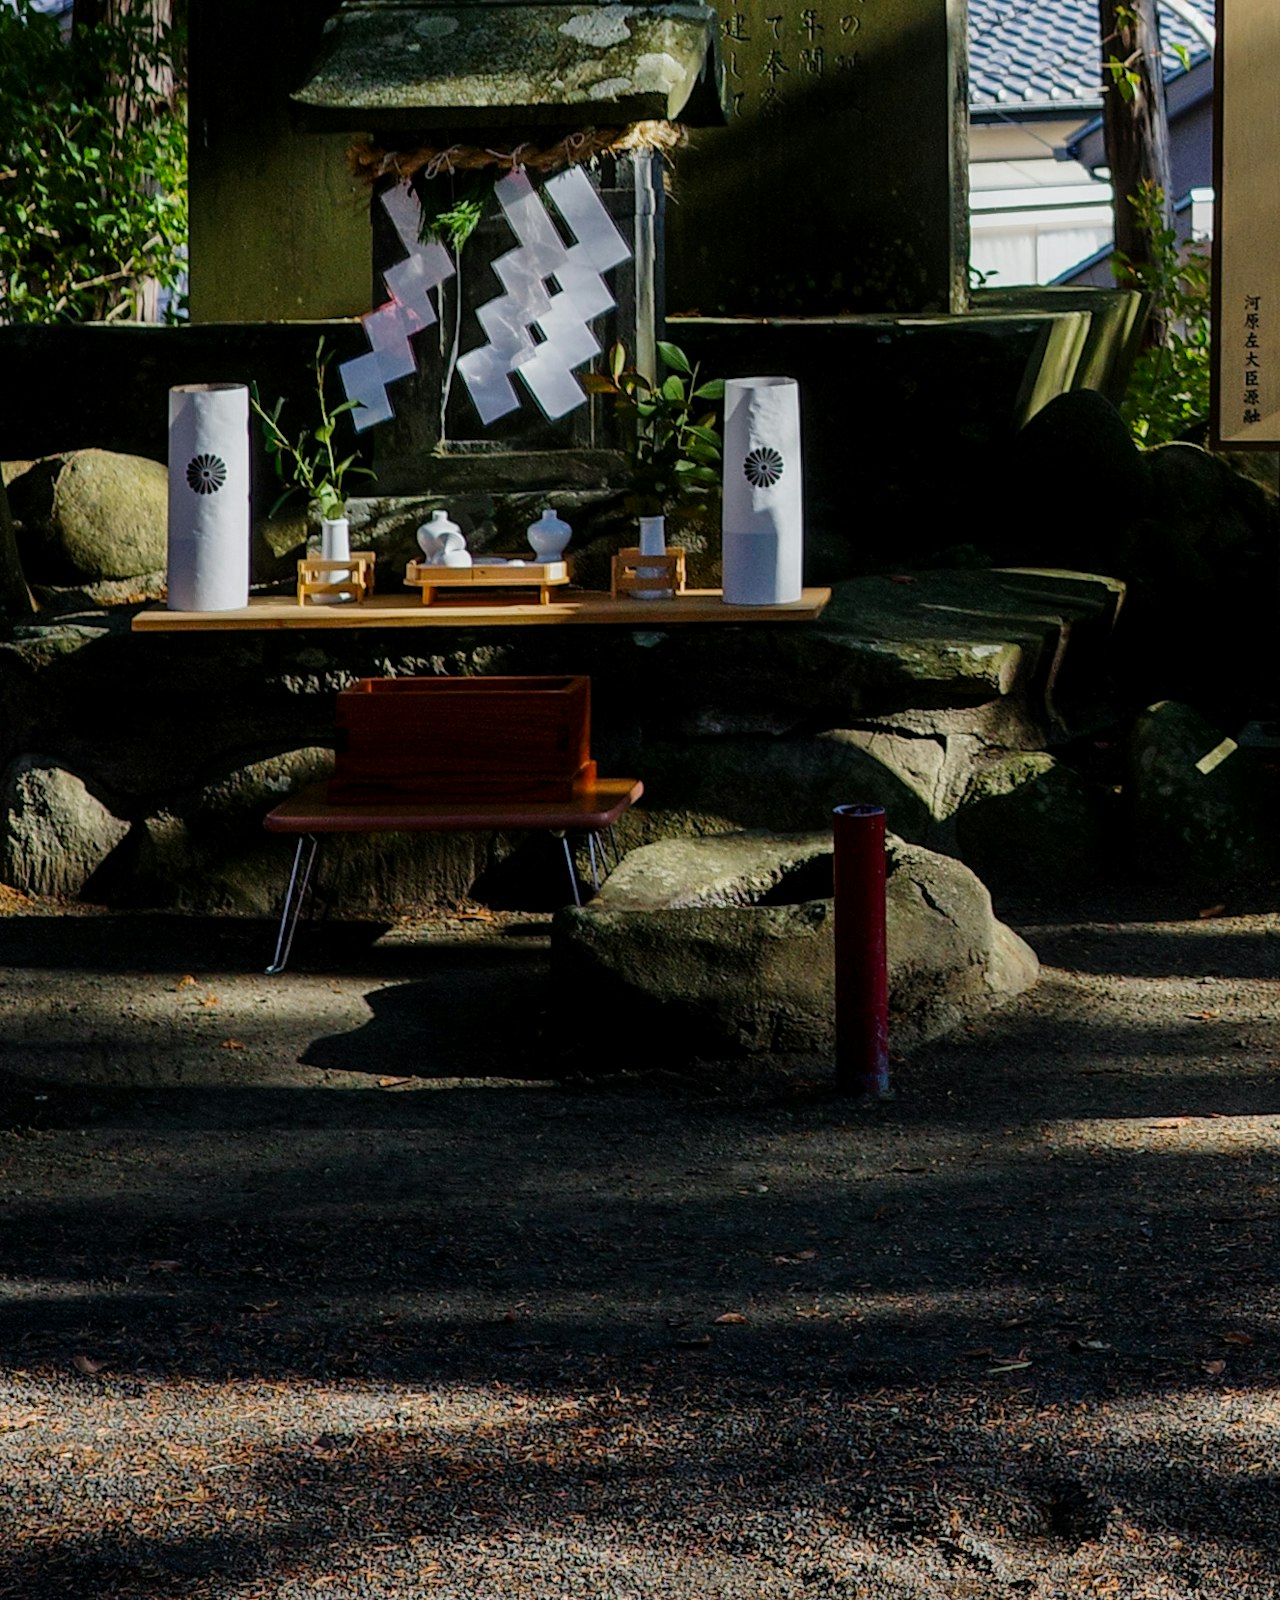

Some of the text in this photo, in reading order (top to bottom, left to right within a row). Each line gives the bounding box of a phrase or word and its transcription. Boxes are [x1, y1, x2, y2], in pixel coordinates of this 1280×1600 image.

[1243, 294, 1261, 424] 河原左大臣源融
